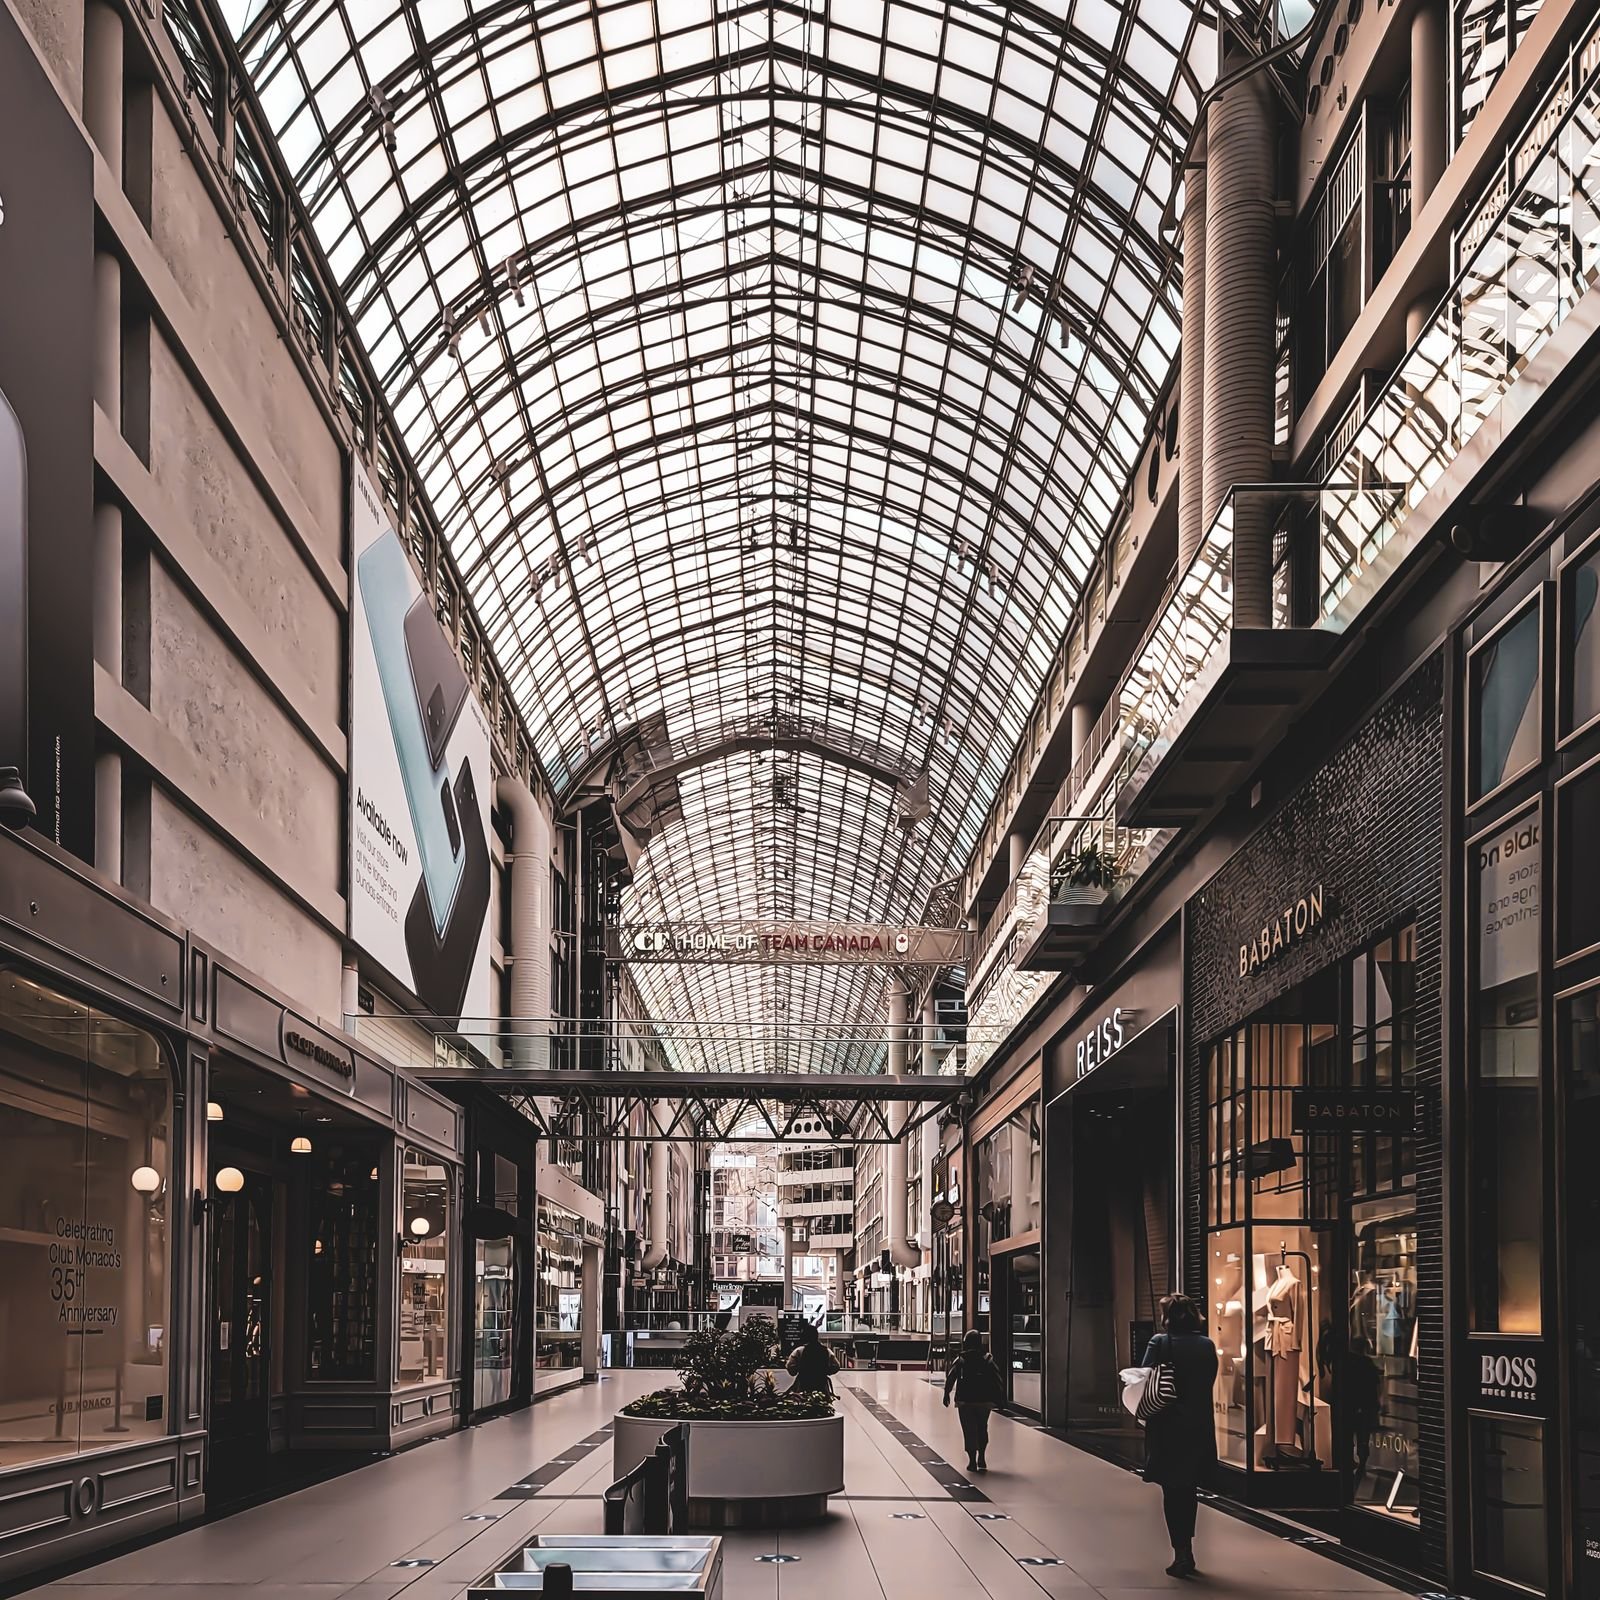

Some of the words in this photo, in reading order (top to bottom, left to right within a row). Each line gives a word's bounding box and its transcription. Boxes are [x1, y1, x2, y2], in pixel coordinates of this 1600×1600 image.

[356, 786, 391, 846] Available
[392, 832, 408, 866] now
[356, 824, 366, 849] Visit
[367, 839, 376, 858] our
[377, 848, 389, 873] store
[356, 868, 376, 902] Dundas
[634, 932, 670, 950] CF
[681, 934, 731, 949] HOME
[736, 934, 758, 949] OF
[761, 935, 808, 950] TEAM
[813, 935, 883, 950] CANADA
[1239, 885, 1324, 978] BABATON
[287, 1032, 314, 1057] CLUB
[315, 1046, 352, 1079] MONACO
[1077, 1007, 1123, 1078] REISS
[1308, 1104, 1401, 1119] BABATON
[56, 1217, 113, 1246] Celebrating
[49, 1243, 73, 1264] Club
[76, 1246, 121, 1268] Monaco's
[51, 1267, 84, 1301] 35th
[59, 1302, 118, 1325] Anniversary
[1481, 1355, 1537, 1388] BOSS
[49, 1400, 73, 1414] CUB
[1366, 1431, 1410, 1454] ABATON
